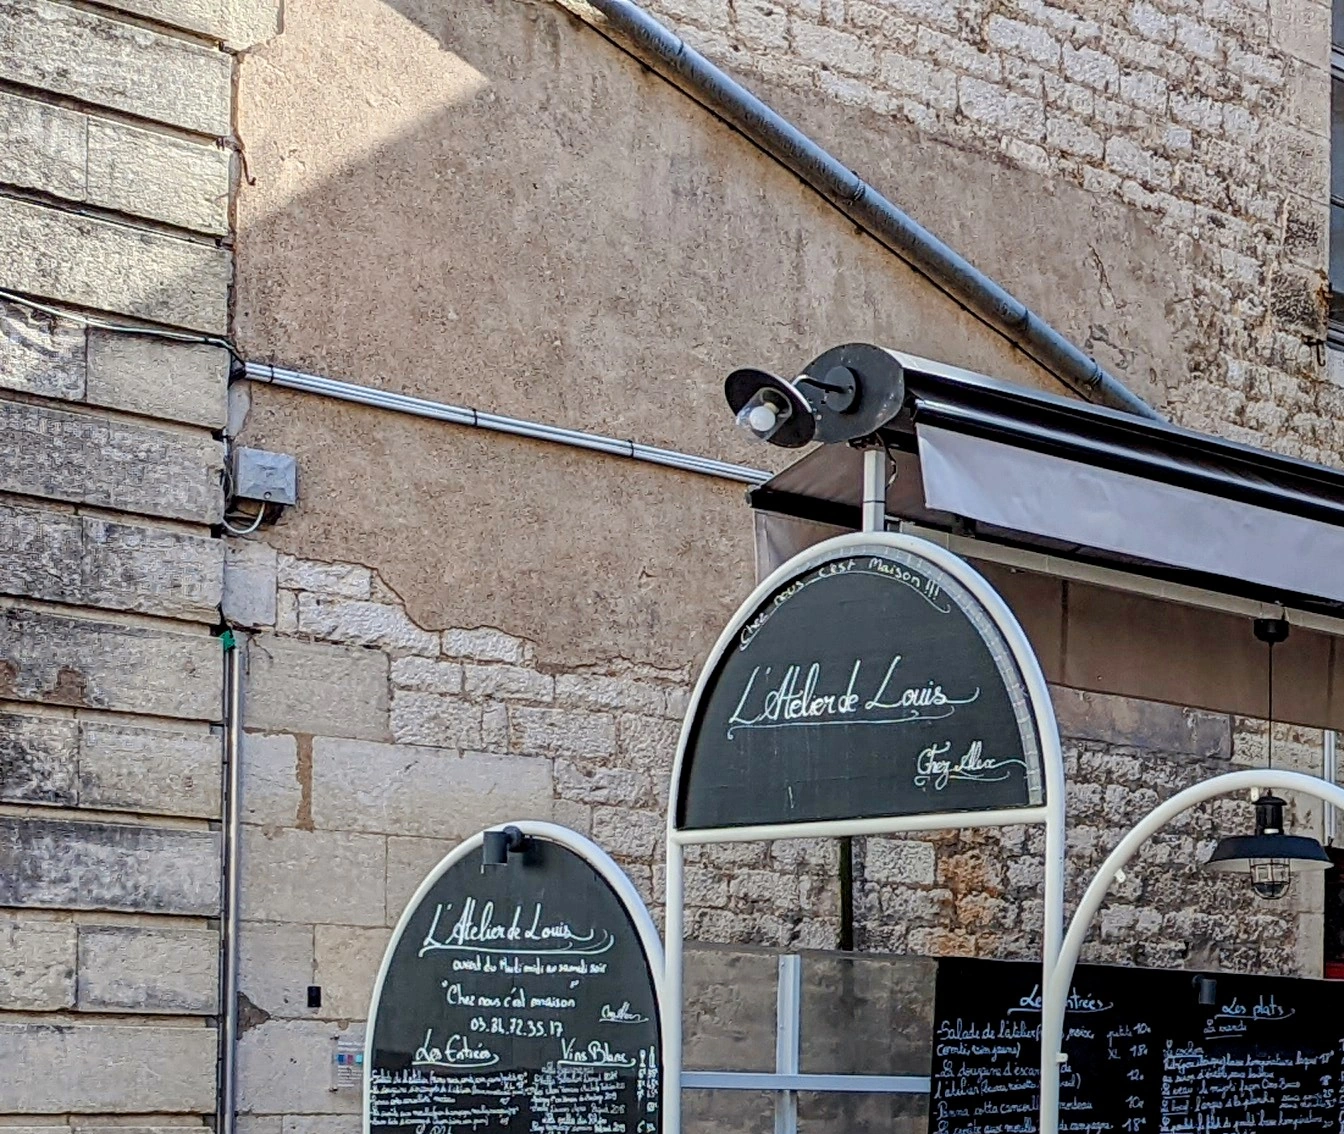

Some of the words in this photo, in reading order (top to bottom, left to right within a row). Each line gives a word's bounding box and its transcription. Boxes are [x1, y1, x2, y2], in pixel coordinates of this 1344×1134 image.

[837, 659, 861, 714] de
[864, 655, 972, 709] Louis
[506, 905, 531, 941] de
[533, 902, 595, 942] Louis
[477, 997, 502, 1008] nous
[1019, 984, 1042, 1009] Le
[981, 1021, 996, 1040] de
[561, 1037, 588, 1062] Vins
